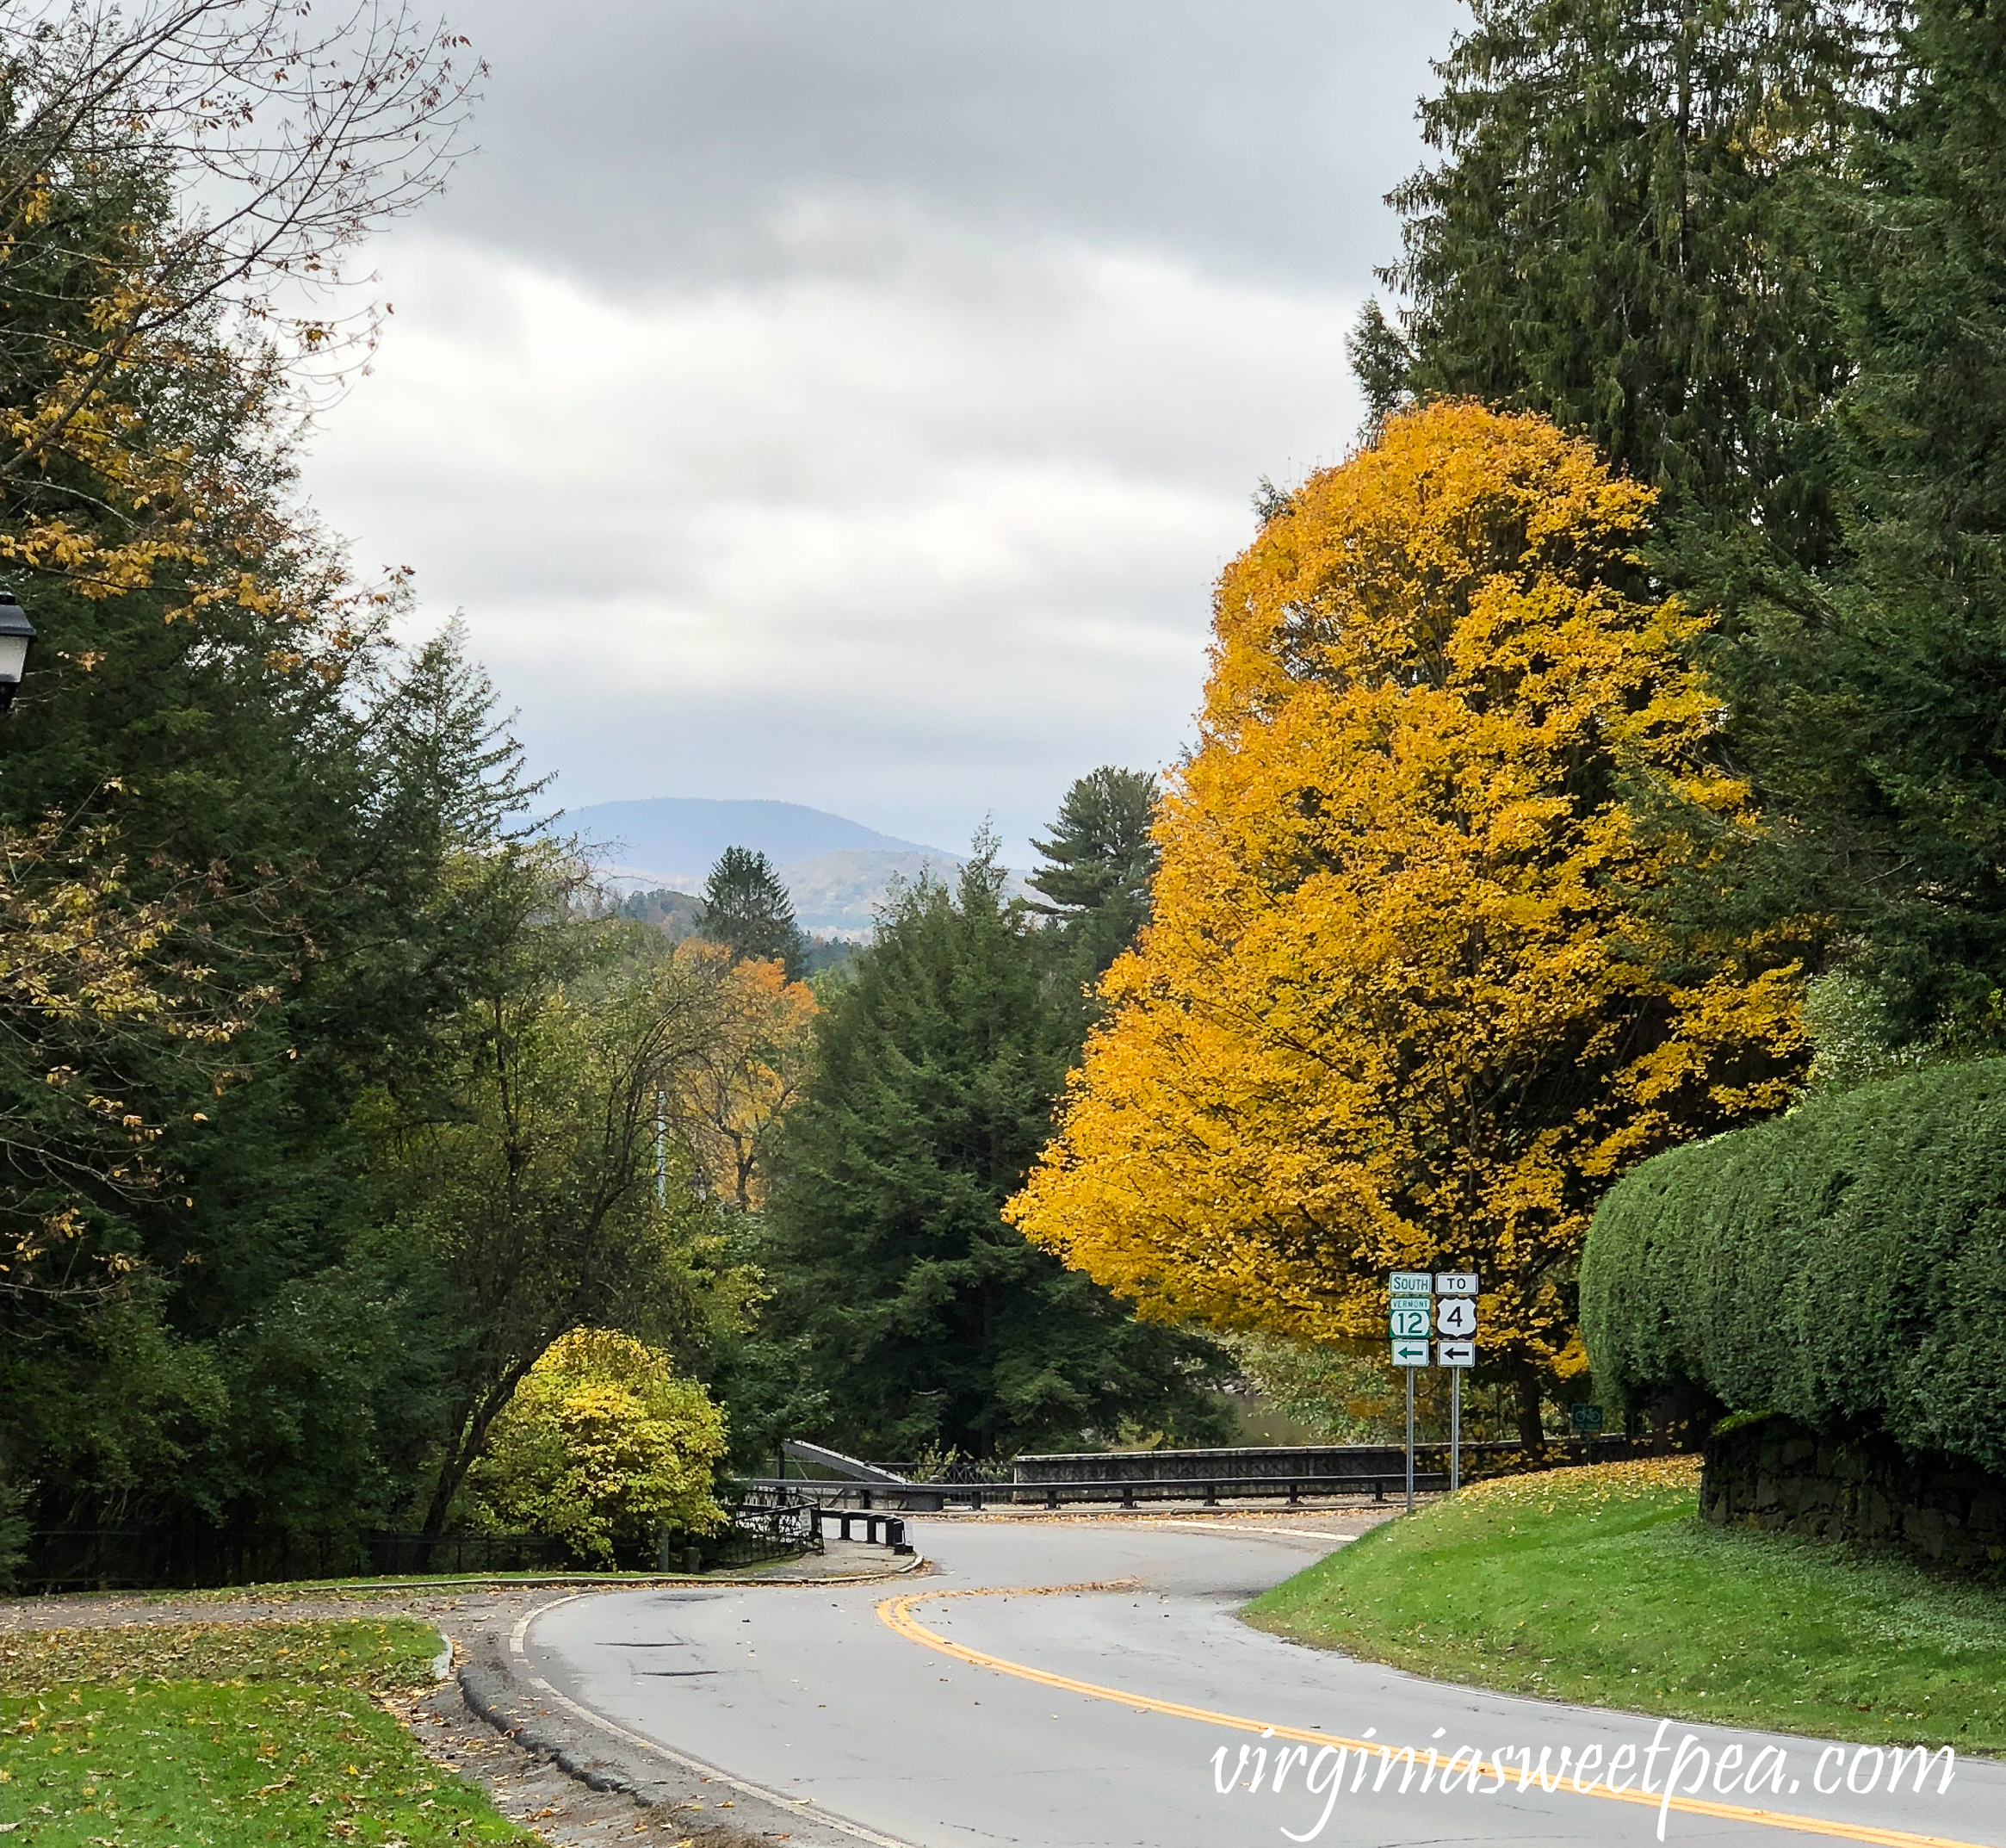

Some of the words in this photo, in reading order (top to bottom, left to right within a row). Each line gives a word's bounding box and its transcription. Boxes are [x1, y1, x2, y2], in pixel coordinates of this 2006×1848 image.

[1394, 1276, 1428, 1290] SOUTH
[1446, 1278, 1466, 1289] TO
[1397, 1312, 1423, 1334] 12
[1446, 1305, 1463, 1327] 4
